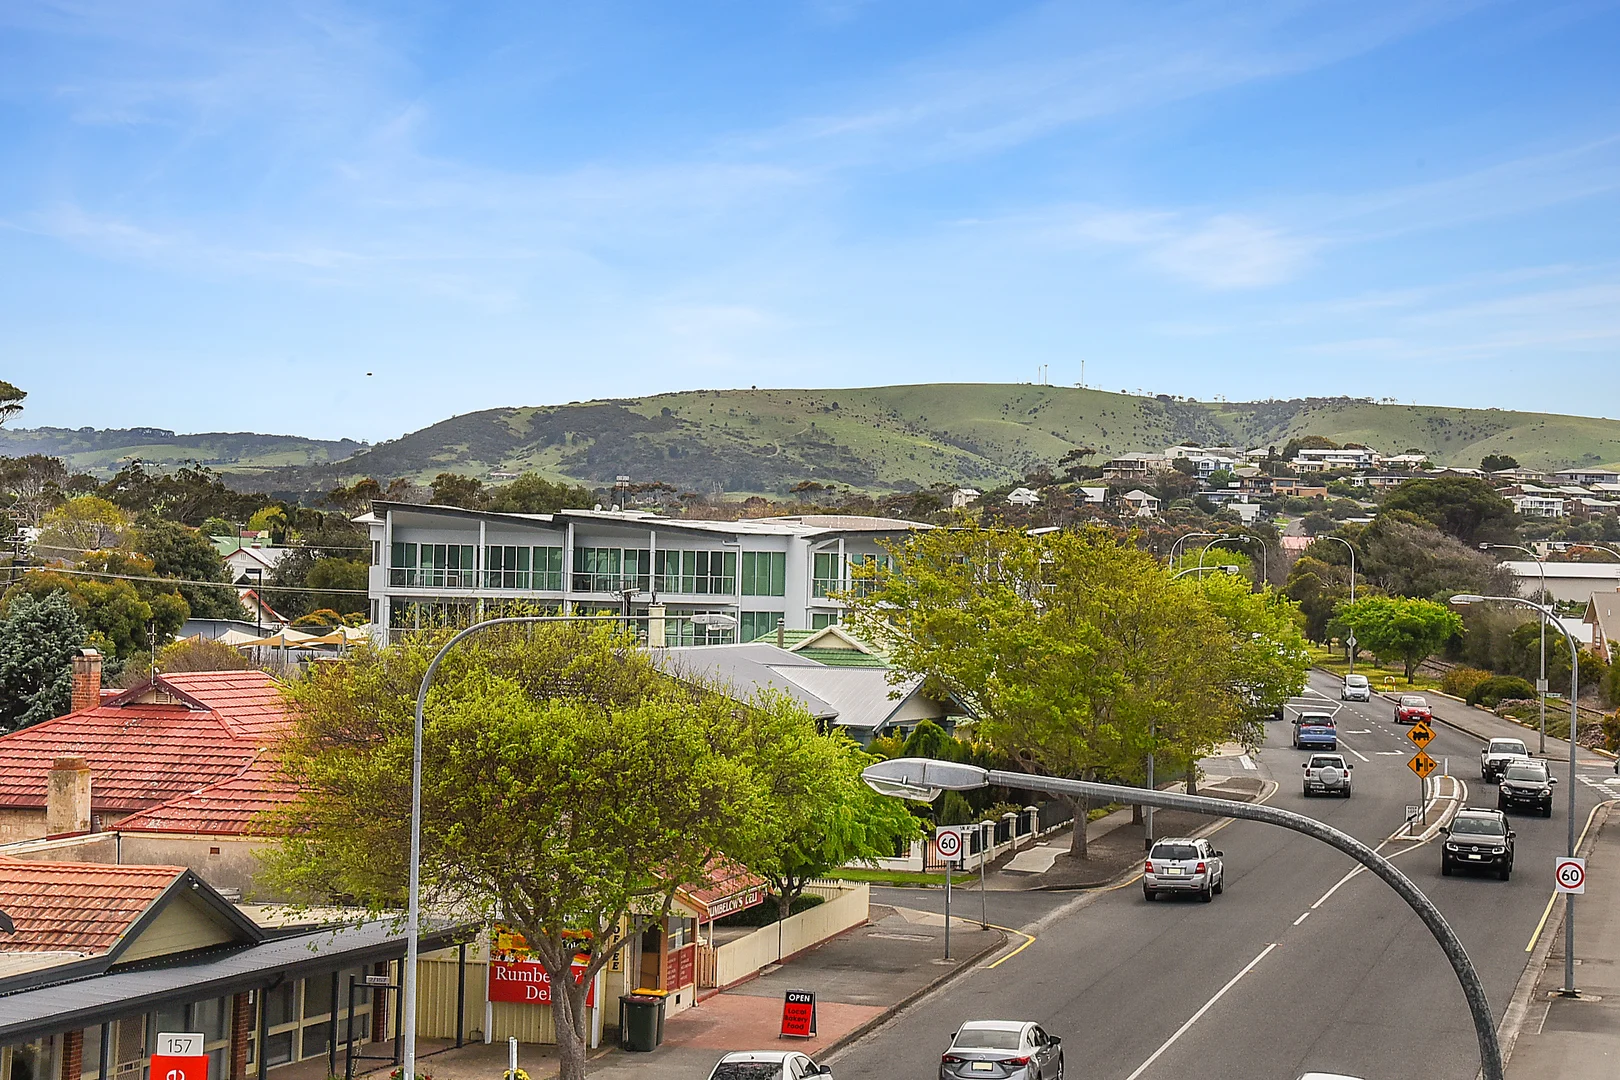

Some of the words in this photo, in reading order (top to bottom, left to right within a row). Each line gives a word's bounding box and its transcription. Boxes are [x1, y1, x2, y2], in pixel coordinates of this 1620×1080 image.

[941, 837, 956, 849] 60
[1561, 869, 1579, 882] 60
[788, 993, 811, 1003] OPEN
[786, 1022, 805, 1030] Food
[167, 1039, 192, 1053] 157
